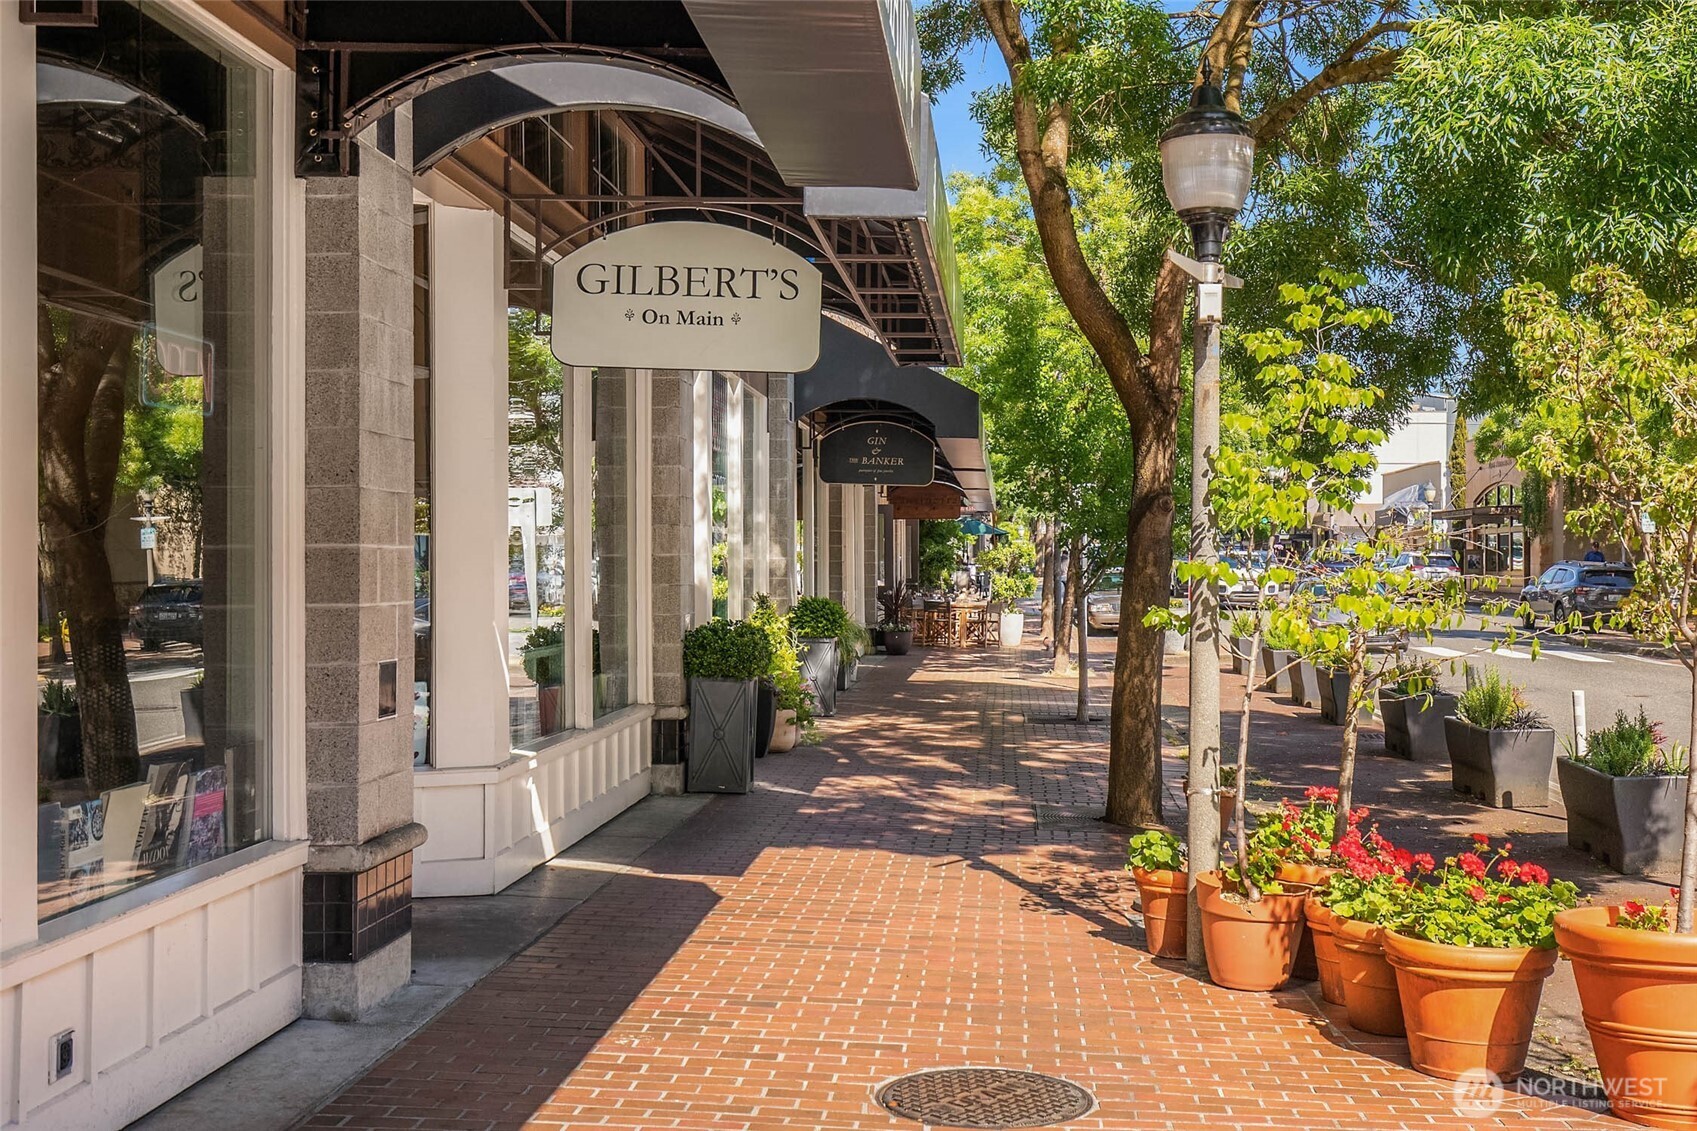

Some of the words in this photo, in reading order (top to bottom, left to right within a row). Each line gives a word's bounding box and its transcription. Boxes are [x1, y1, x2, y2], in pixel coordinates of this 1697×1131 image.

[576, 263, 799, 300] GILBERT'S
[641, 308, 670, 325] On
[676, 310, 724, 326] Main
[867, 436, 887, 445] GIN
[871, 447, 881, 455] &
[862, 456, 904, 466] BANKER
